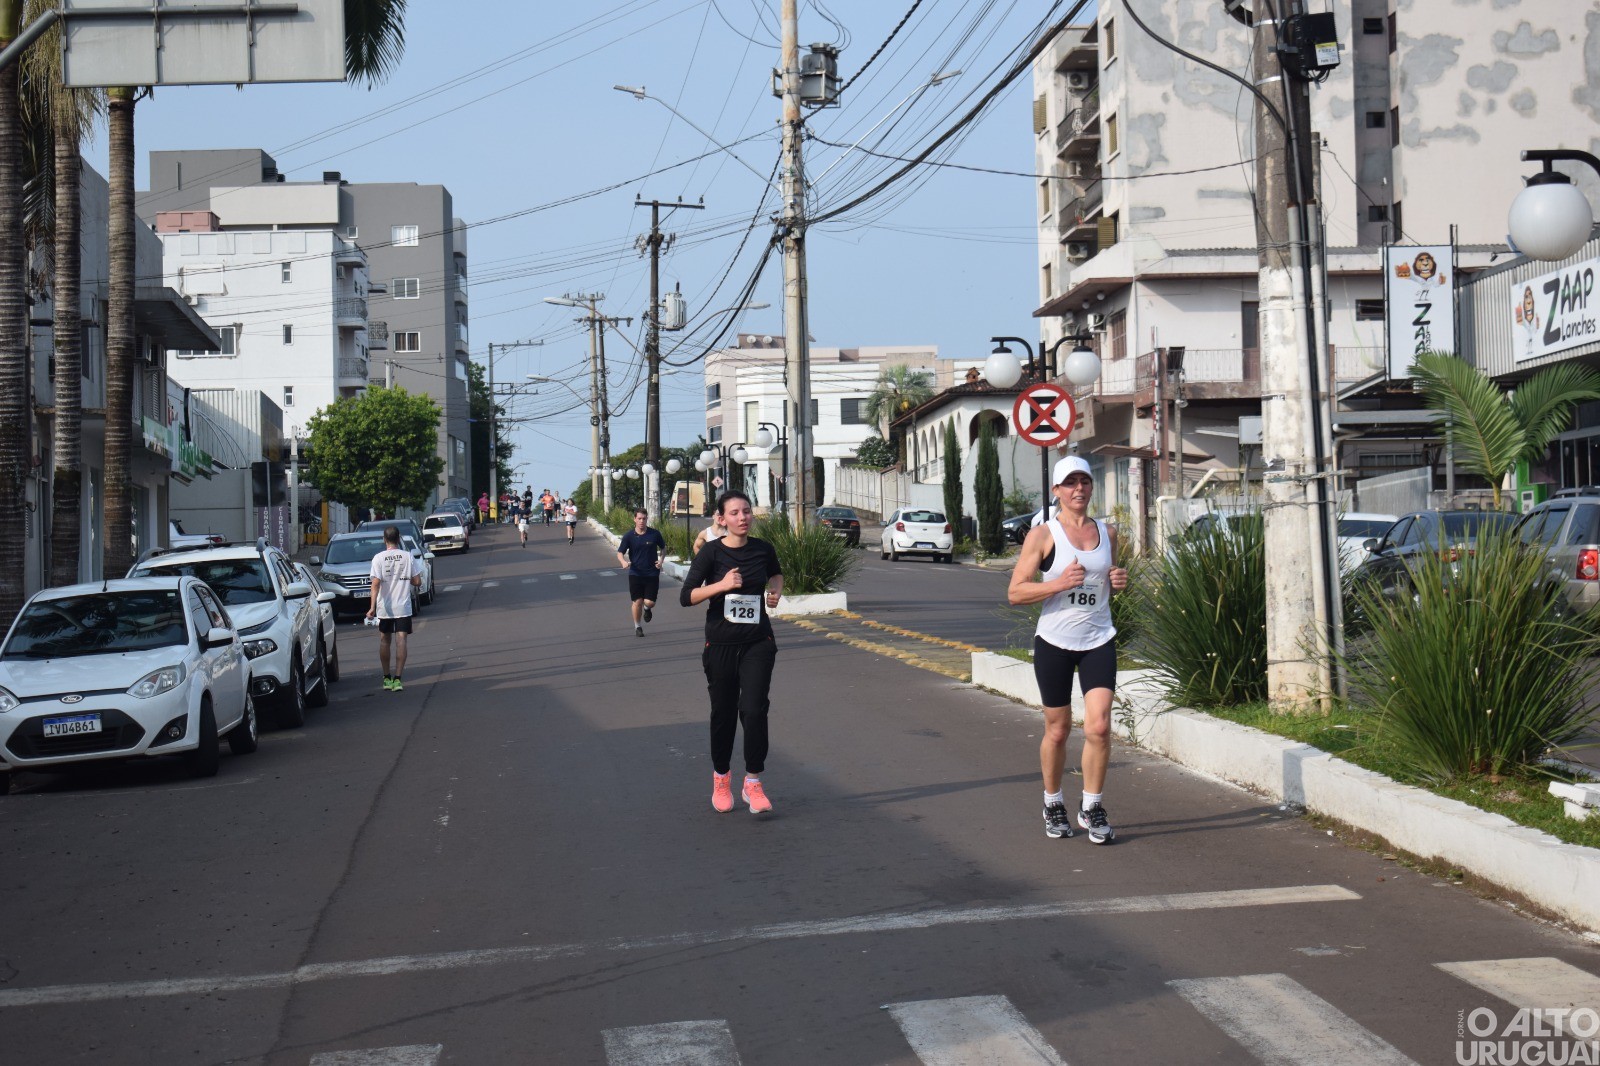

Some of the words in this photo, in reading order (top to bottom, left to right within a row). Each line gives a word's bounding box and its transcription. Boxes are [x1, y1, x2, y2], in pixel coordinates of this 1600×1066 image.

[1543, 267, 1594, 346] ZAAP
[1561, 313, 1596, 341] Lanches
[1067, 592, 1096, 605] 186
[730, 607, 754, 618] 128
[49, 720, 95, 735] IVD4B61
